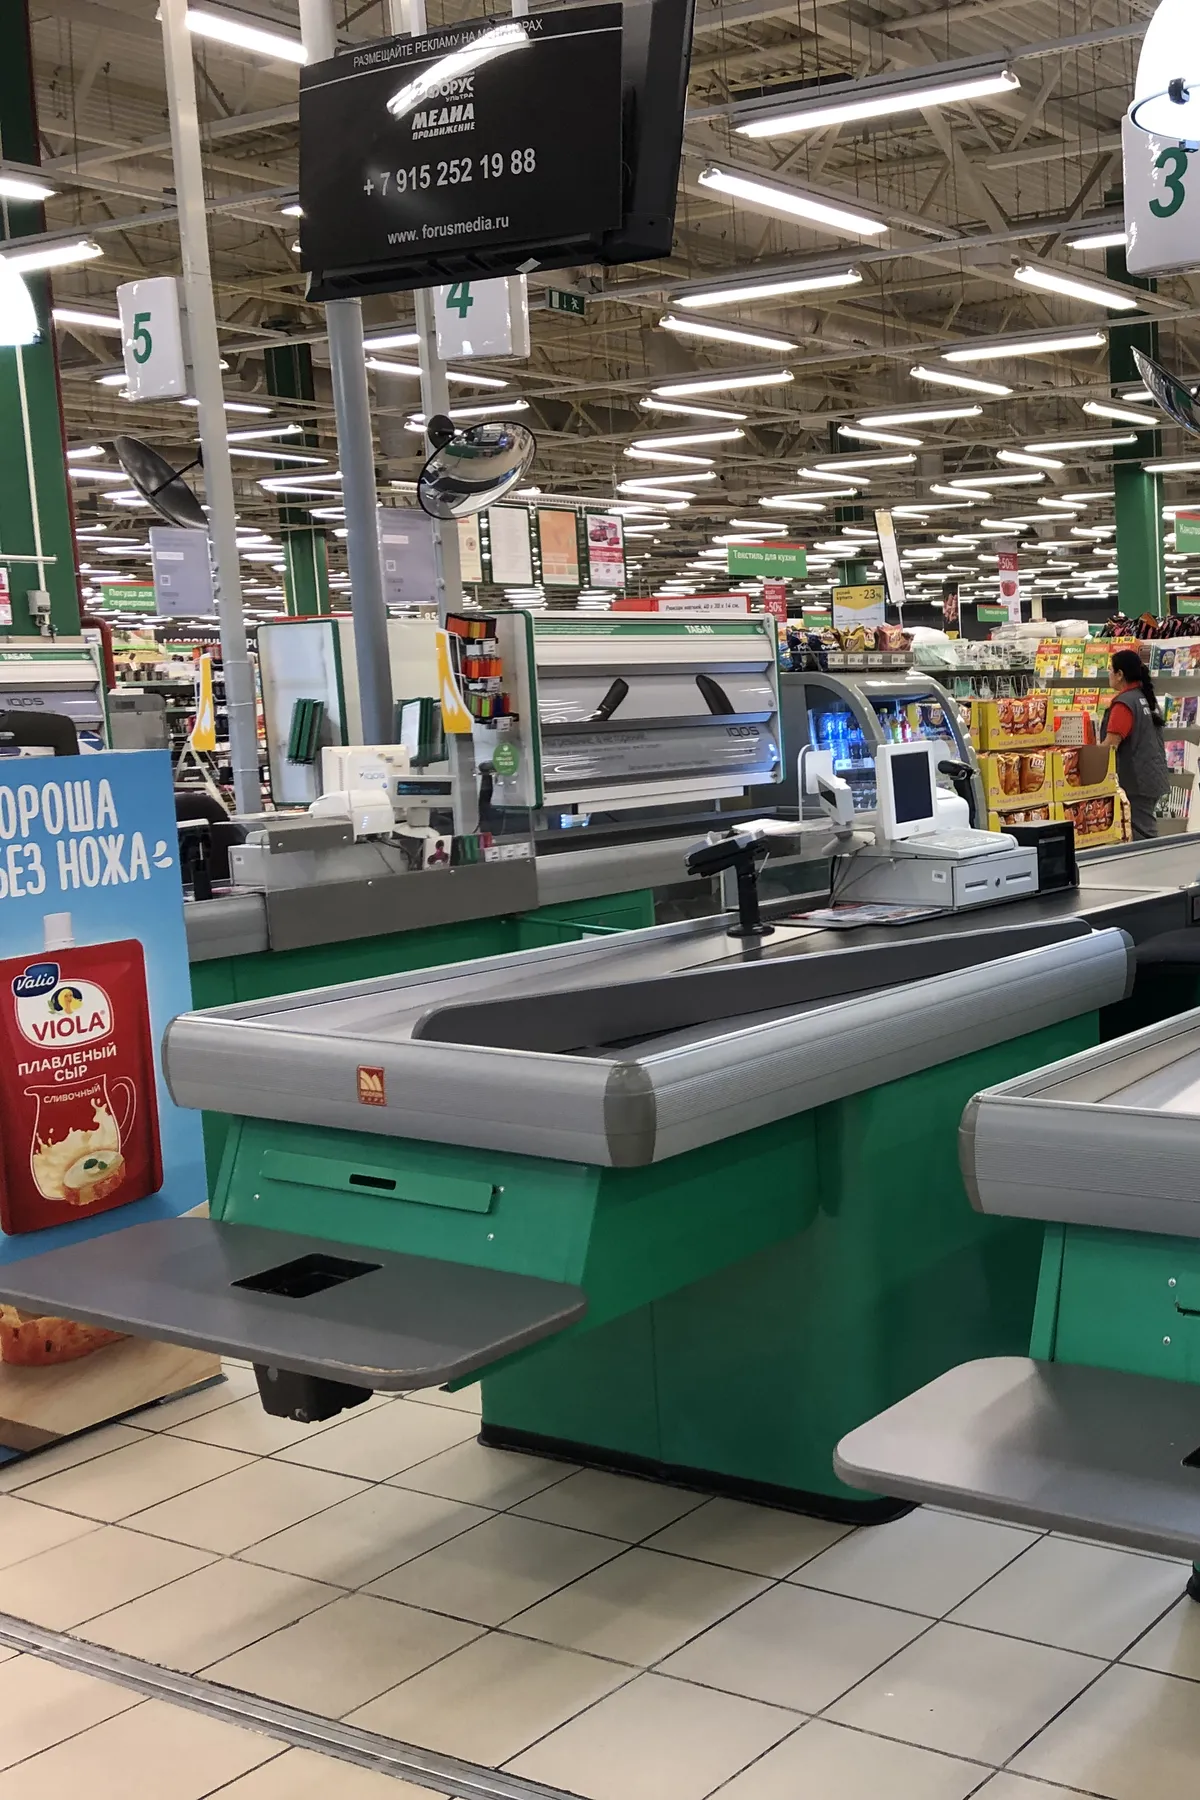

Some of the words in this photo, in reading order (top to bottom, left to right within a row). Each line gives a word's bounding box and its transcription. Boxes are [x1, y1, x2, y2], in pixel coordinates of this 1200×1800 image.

[353, 43, 413, 68] РАЗМЕЩАЙТЕ
[415, 34, 460, 54] РЕКЛАМУ
[461, 31, 476, 44] НА
[411, 103, 475, 130] МЕДИА
[412, 121, 476, 140] ПРОДВИЖЕНИЕ
[380, 172, 391, 196] 7
[396, 164, 430, 192] 915
[437, 158, 472, 186] 252
[480, 153, 504, 179] 19
[510, 148, 536, 174] 88
[1148, 146, 1188, 219] 3
[446, 281, 473, 319] 4
[132, 312, 153, 364] 5
[732, 549, 764, 560] Текстиль
[764, 553, 777, 561] для
[684, 625, 714, 634] ТАБАК
[56, 831, 151, 891] НОЖА
[16, 973, 55, 991] Valio
[31, 1012, 106, 1041] VIOLA
[18, 1042, 117, 1076] ПЛАВЛЕНЫЙ
[54, 1065, 88, 1082] СЫР
[43, 1083, 101, 1104] СЛИВОЧНЫЙ
